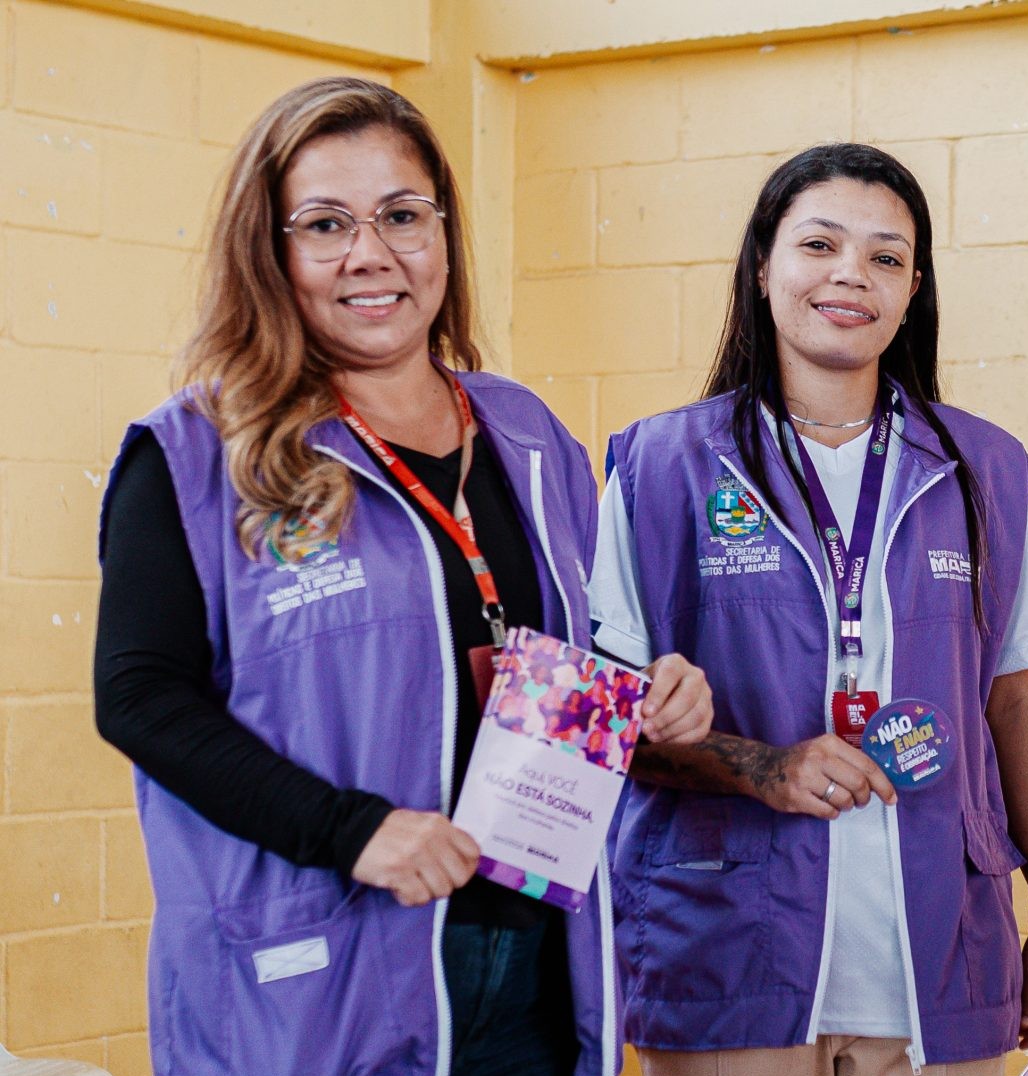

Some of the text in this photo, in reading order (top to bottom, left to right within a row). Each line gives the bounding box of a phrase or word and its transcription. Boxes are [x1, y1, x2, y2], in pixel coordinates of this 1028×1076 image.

[726, 546, 780, 556] SECRETARIA DE
[737, 555, 762, 564] DEFESA
[765, 554, 780, 562] DOS
[726, 565, 742, 575] DAS
[744, 562, 780, 573] MULHERES
[877, 715, 912, 745] NÃO
[902, 723, 935, 749] NÃO!
[897, 743, 928, 764] RESPEITO
